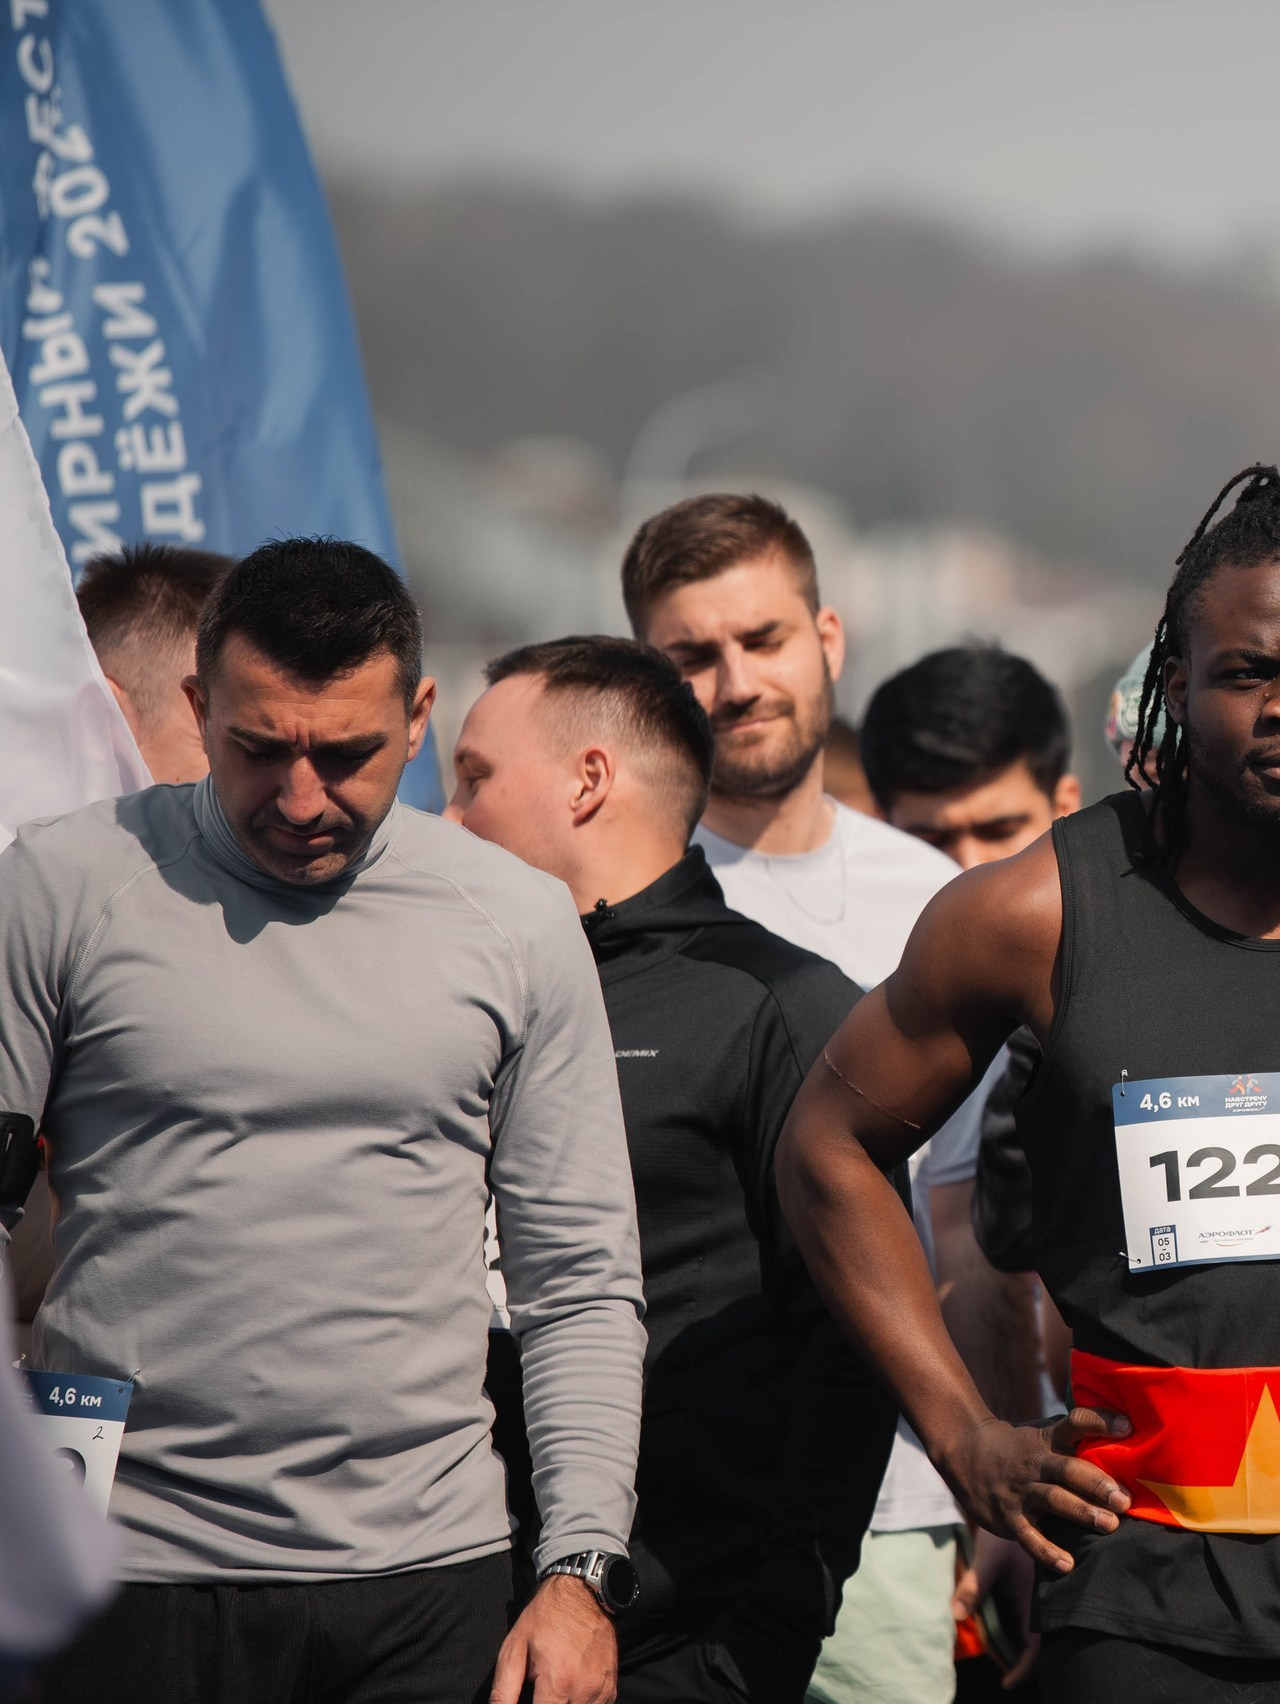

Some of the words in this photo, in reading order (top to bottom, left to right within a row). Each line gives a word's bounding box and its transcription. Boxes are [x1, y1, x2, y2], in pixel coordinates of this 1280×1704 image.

[1140, 1092, 1172, 1112] 4,6
[1199, 1229, 1254, 1239] АЭРОФЛОТ
[1158, 1237, 1170, 1247] 05
[1159, 1252, 1171, 1262] 03
[49, 1386, 77, 1406] 4,6
[92, 1425, 104, 1440] 2
